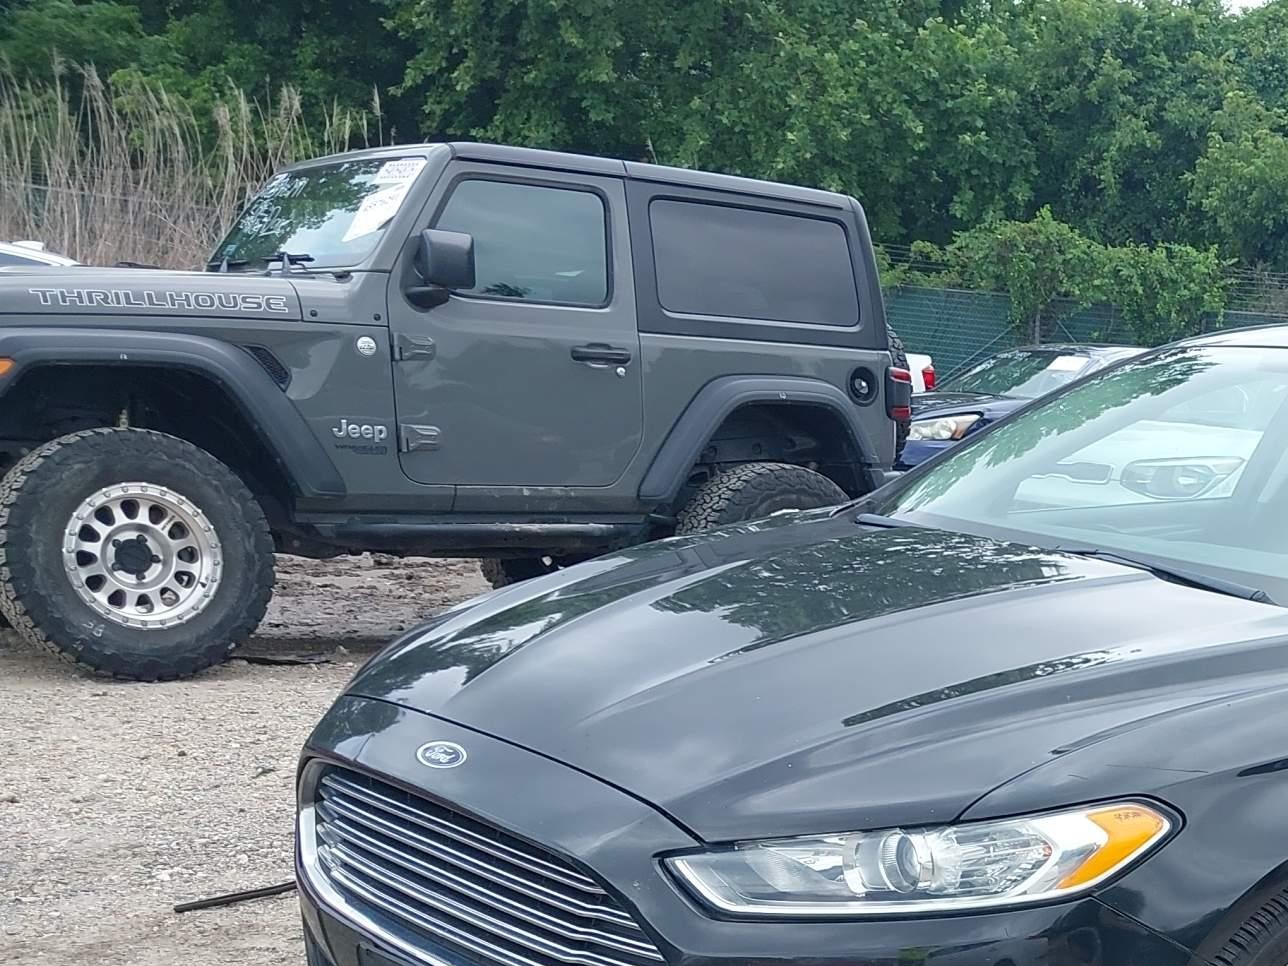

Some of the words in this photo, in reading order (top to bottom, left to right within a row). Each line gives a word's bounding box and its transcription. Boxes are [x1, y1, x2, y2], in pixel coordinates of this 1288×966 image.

[29, 288, 289, 313] THRILLHOUSE
[332, 419, 388, 443] Jeep
[425, 746, 456, 763] Ford
